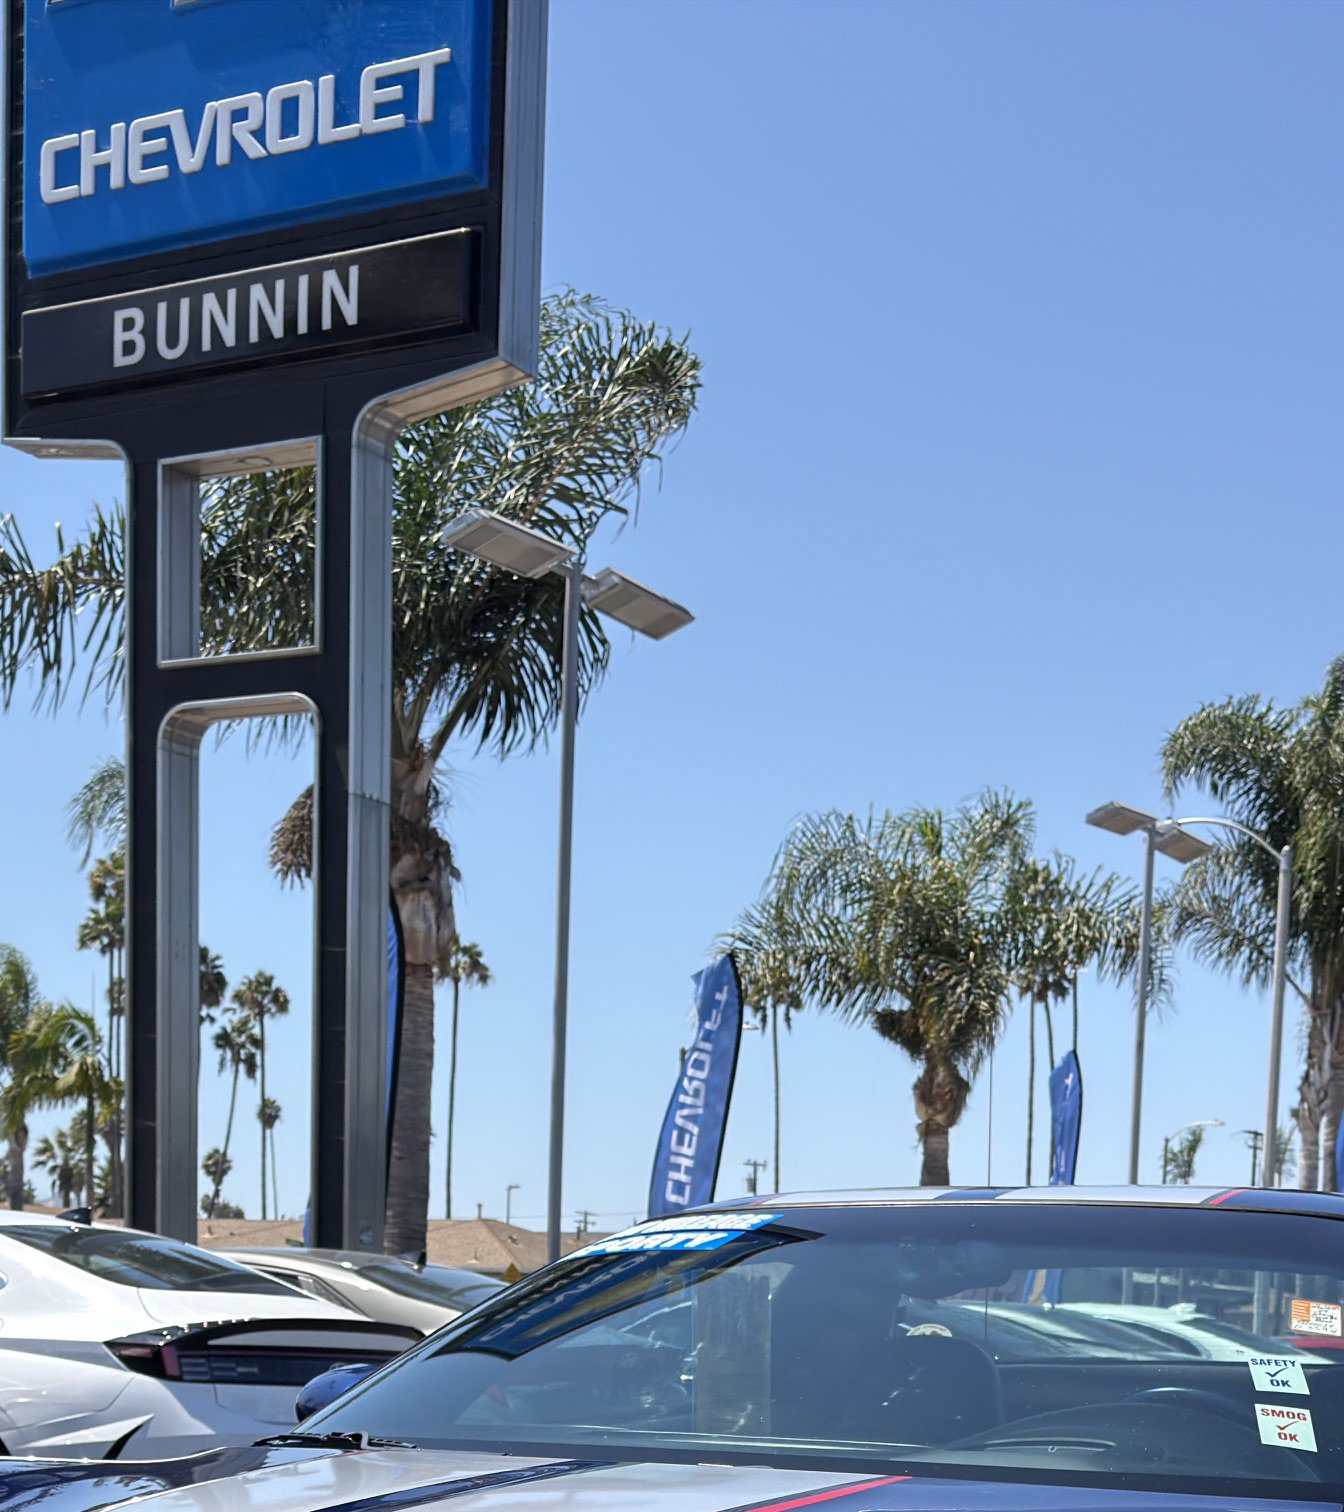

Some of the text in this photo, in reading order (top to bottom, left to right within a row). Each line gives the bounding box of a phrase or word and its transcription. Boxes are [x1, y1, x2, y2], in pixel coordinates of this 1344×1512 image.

[40, 48, 451, 204] CHEVROLET
[112, 264, 359, 368] BUNNIN
[1250, 1358, 1296, 1367] SAFETY
[1269, 1379, 1292, 1388] OK
[1260, 1408, 1307, 1421] SMOG
[1277, 1432, 1300, 1443] OK
